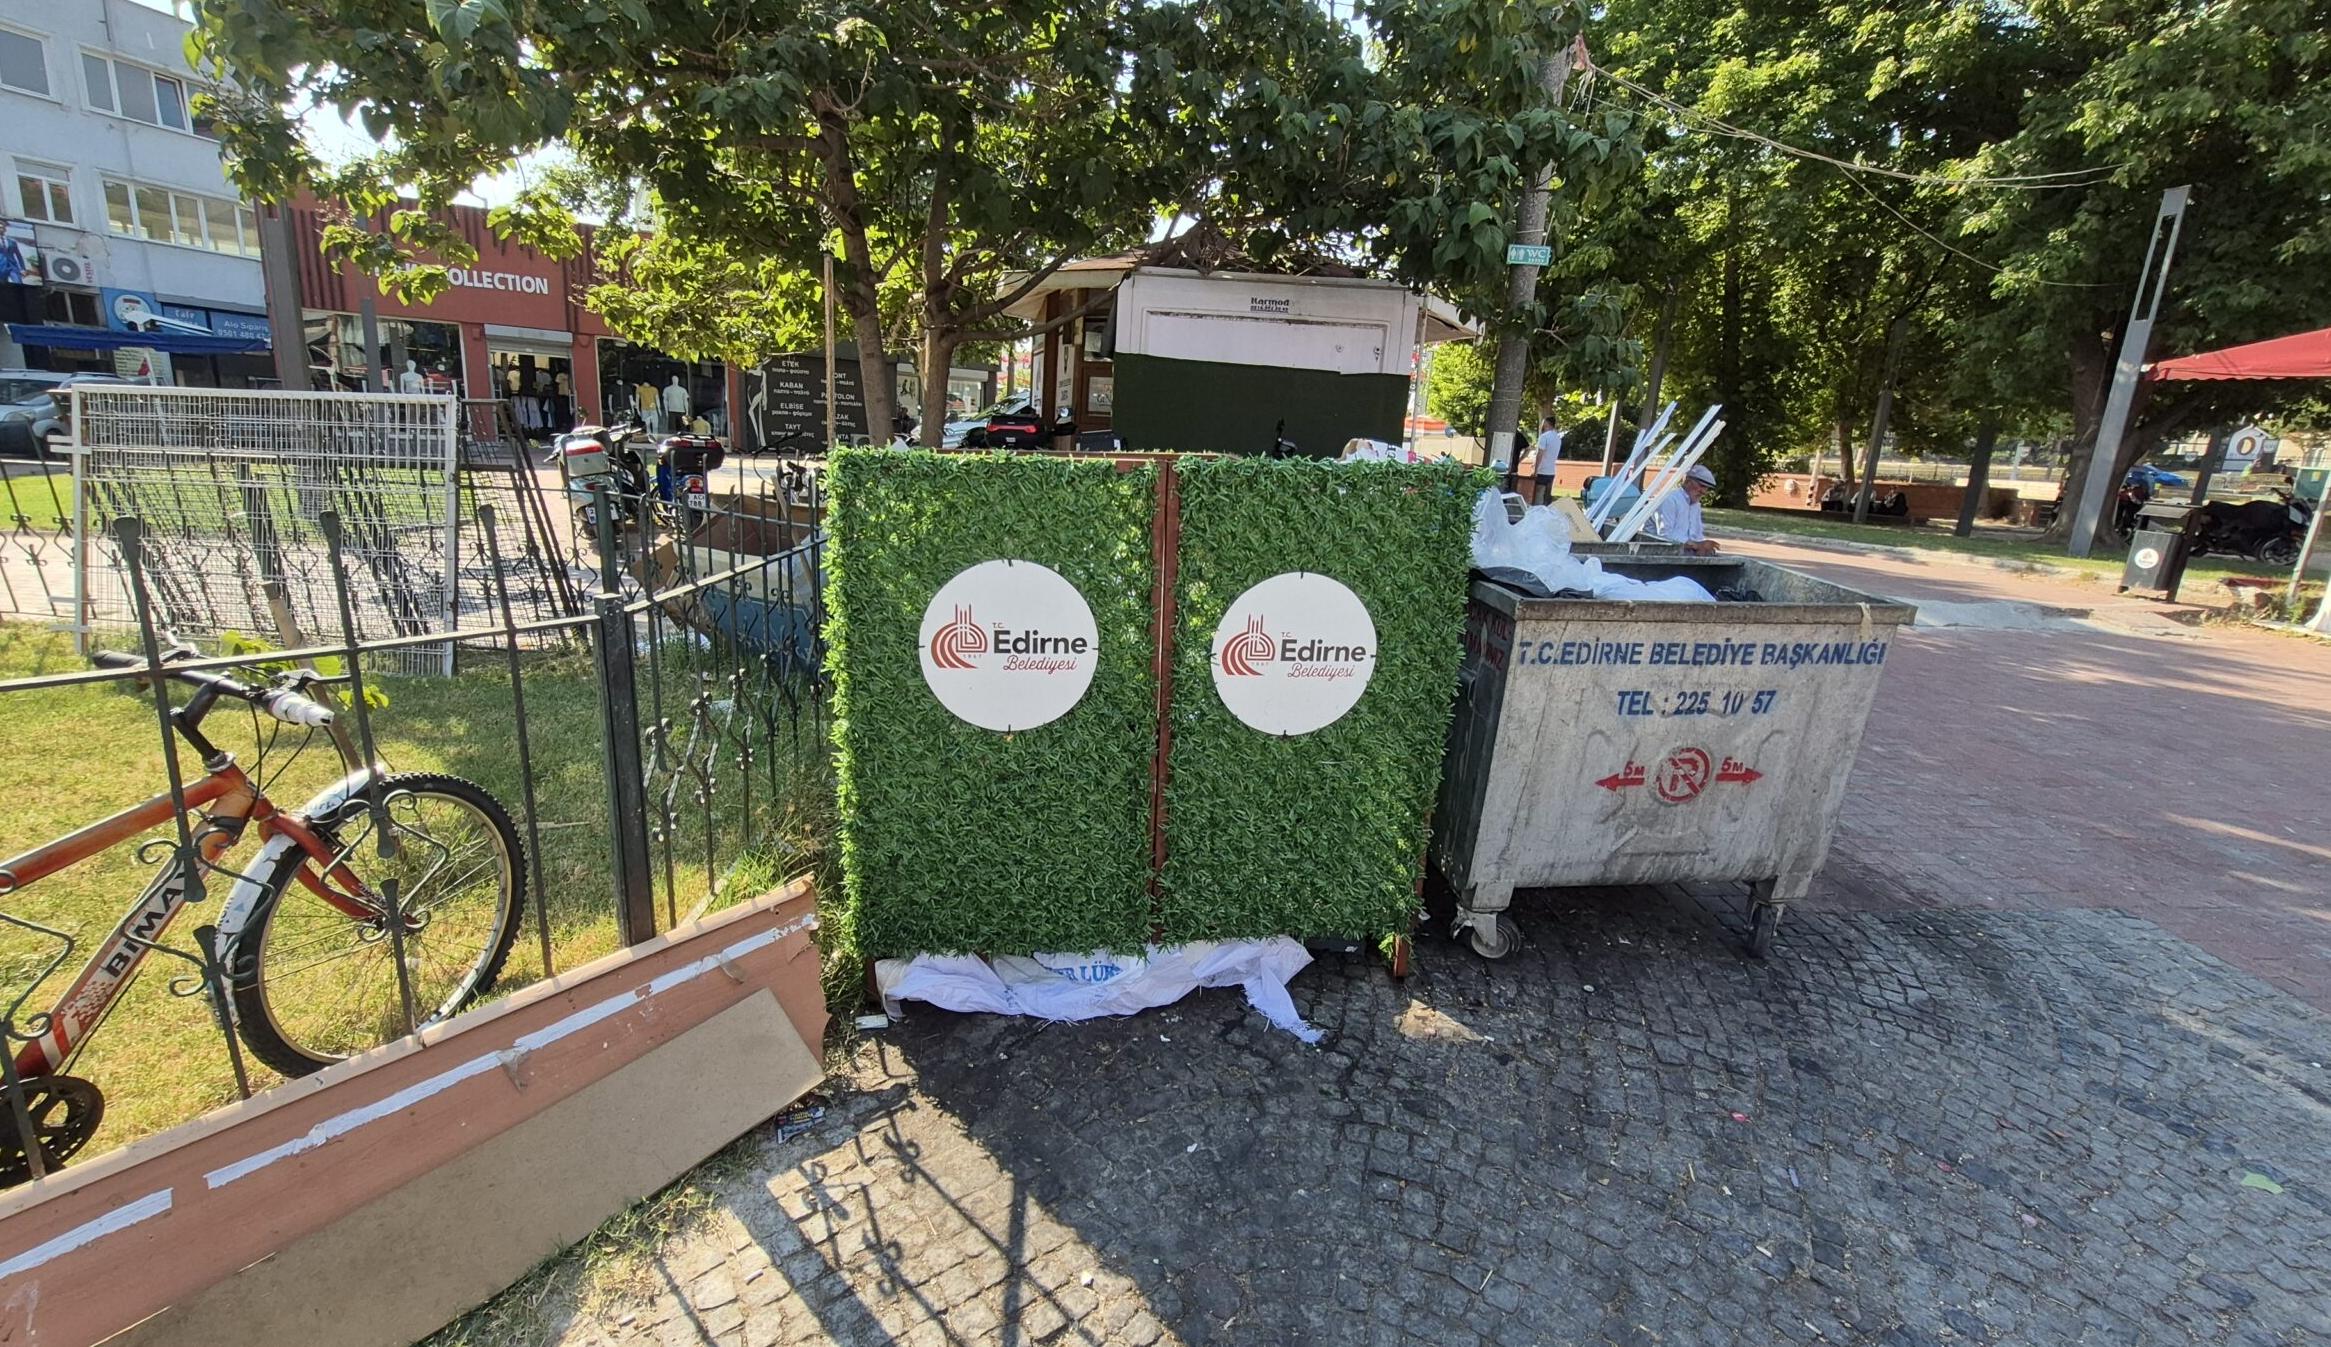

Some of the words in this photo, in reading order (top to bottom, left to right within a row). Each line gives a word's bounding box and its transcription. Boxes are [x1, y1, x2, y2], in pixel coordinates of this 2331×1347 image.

[1527, 249, 1546, 259] WC
[448, 268, 548, 294] OLLECTION
[993, 629, 1088, 655] Edirne
[1280, 638, 1367, 662] Edirne
[1648, 637, 1757, 666] BELEDİYE
[1760, 637, 1888, 670] BAŞKANLIĞI
[1003, 654, 1078, 675] Belediyesi
[1287, 662, 1356, 682] Belediyesi
[1673, 690, 1712, 716] 225
[1722, 691, 1744, 715] 10
[1751, 690, 1777, 714] 57
